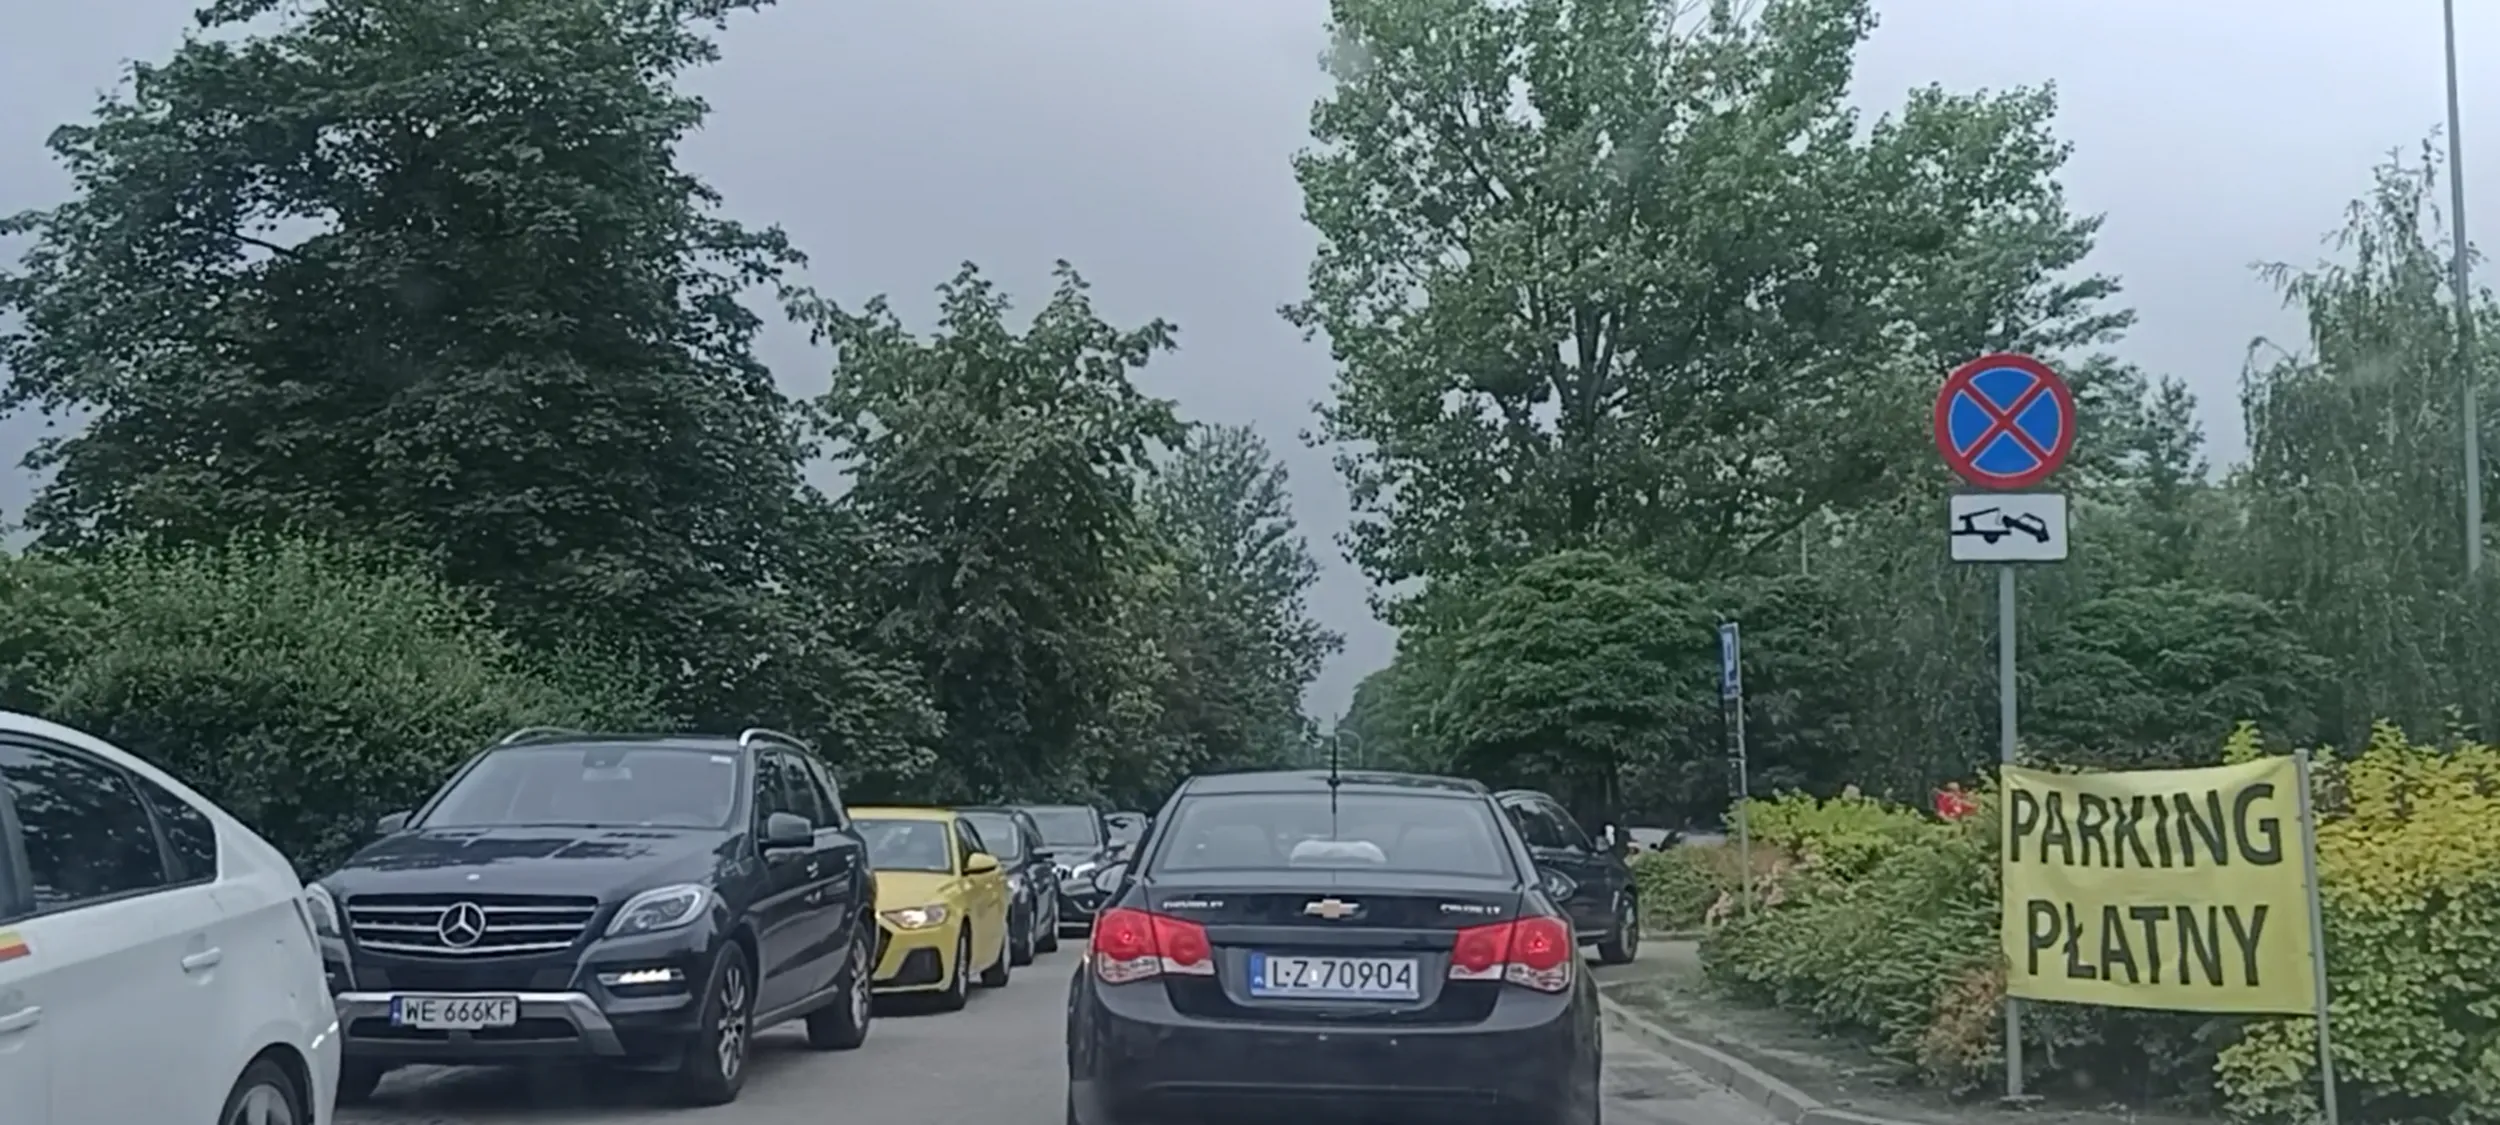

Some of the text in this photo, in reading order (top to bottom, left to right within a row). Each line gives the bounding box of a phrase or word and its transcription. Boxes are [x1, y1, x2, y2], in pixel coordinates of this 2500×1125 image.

[2009, 783, 2283, 868] PARKING
[2027, 899, 2269, 986] PŁATNY
[1273, 960, 1411, 990] LZ 70904
[406, 1000, 512, 1022] WE 666KF
